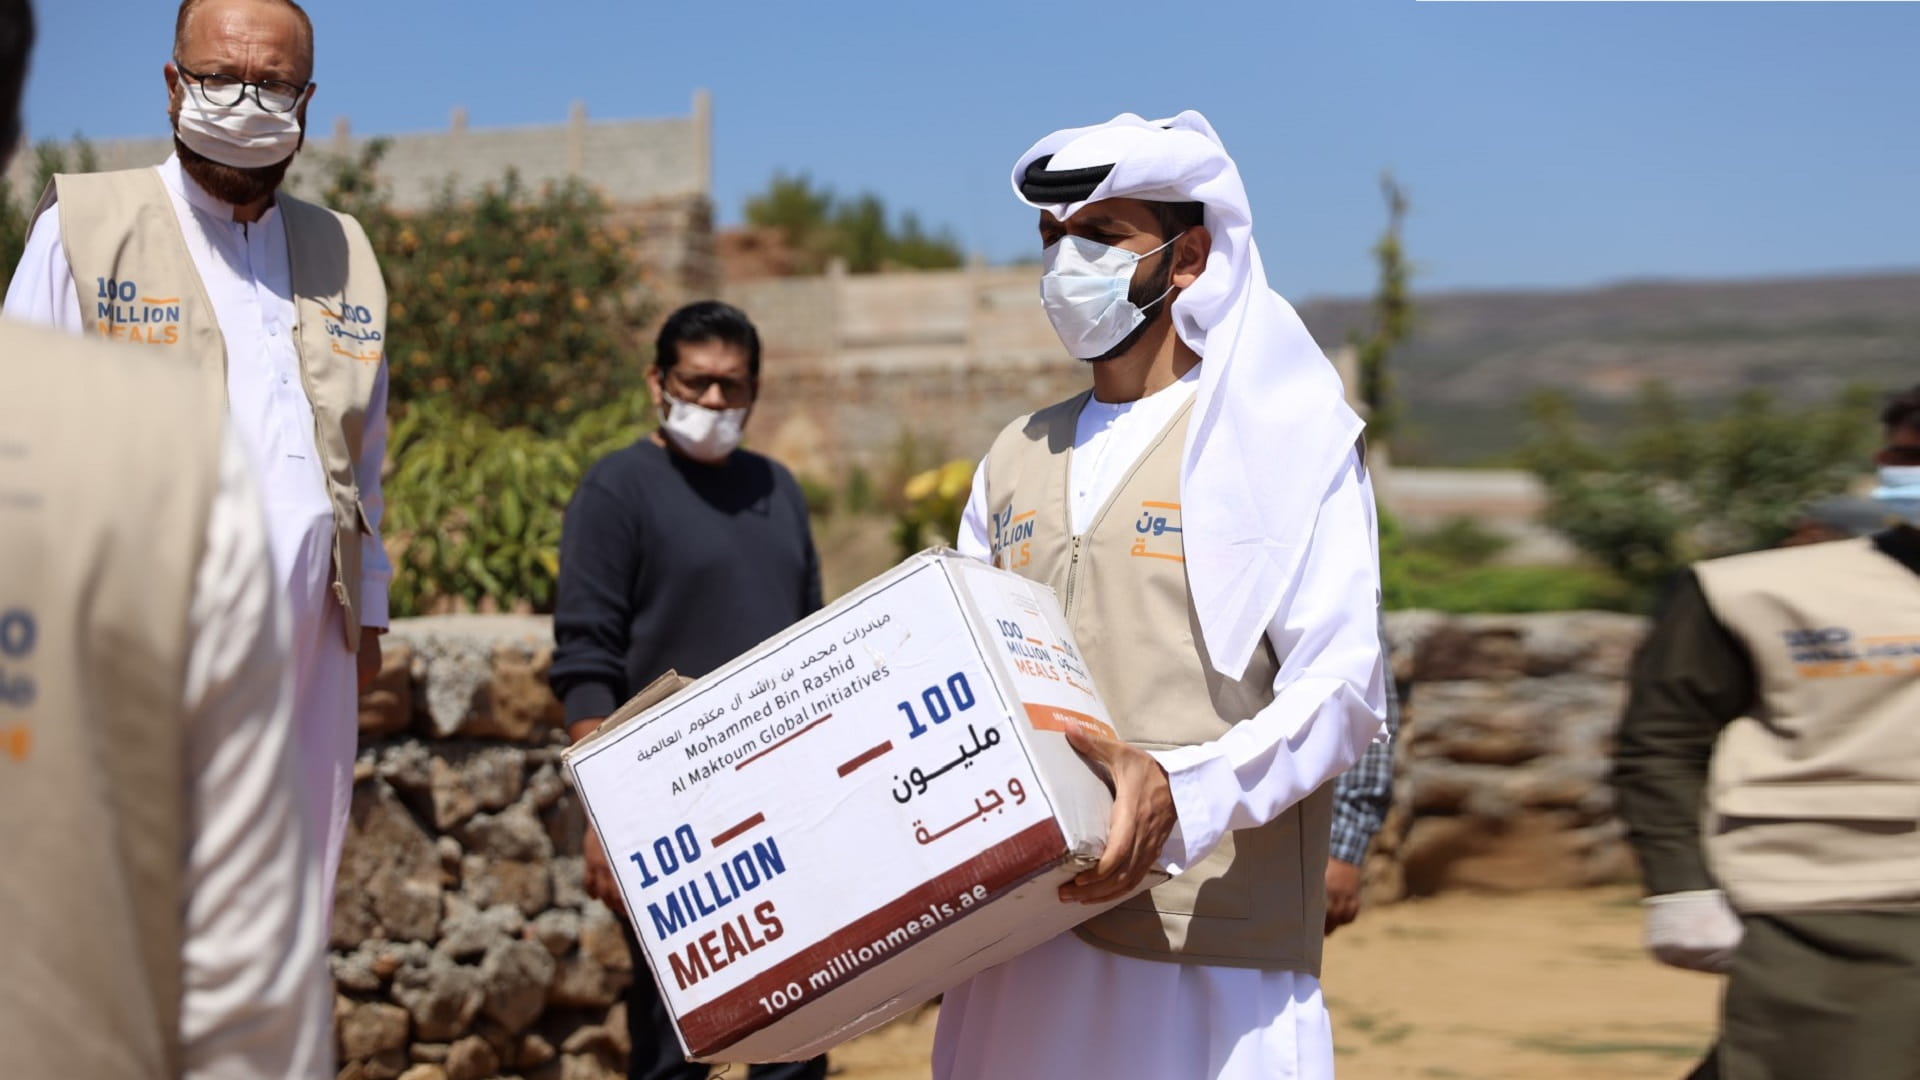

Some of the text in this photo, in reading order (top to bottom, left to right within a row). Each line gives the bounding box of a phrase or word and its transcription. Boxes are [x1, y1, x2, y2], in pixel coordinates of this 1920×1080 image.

[842, 614, 890, 645] مبادرات
[996, 618, 1023, 640] 100
[800, 643, 837, 670] محمد
[1006, 640, 1052, 662] MILLION
[781, 667, 795, 682] بن
[1014, 657, 1060, 681] MEALS
[748, 678, 776, 700] راشد
[897, 671, 975, 739] 100
[684, 654, 855, 761] Mohammed Bin Rashid
[688, 707, 725, 735] مكتوم
[637, 729, 682, 762] العالمية
[672, 665, 890, 796] Al Maktoum Global Initiatives
[892, 723, 1000, 804] مليون
[630, 823, 701, 889] 100
[647, 836, 786, 941] MILLION
[667, 900, 784, 991] MEALS
[758, 884, 987, 1015] 100 millionmeals.ae
